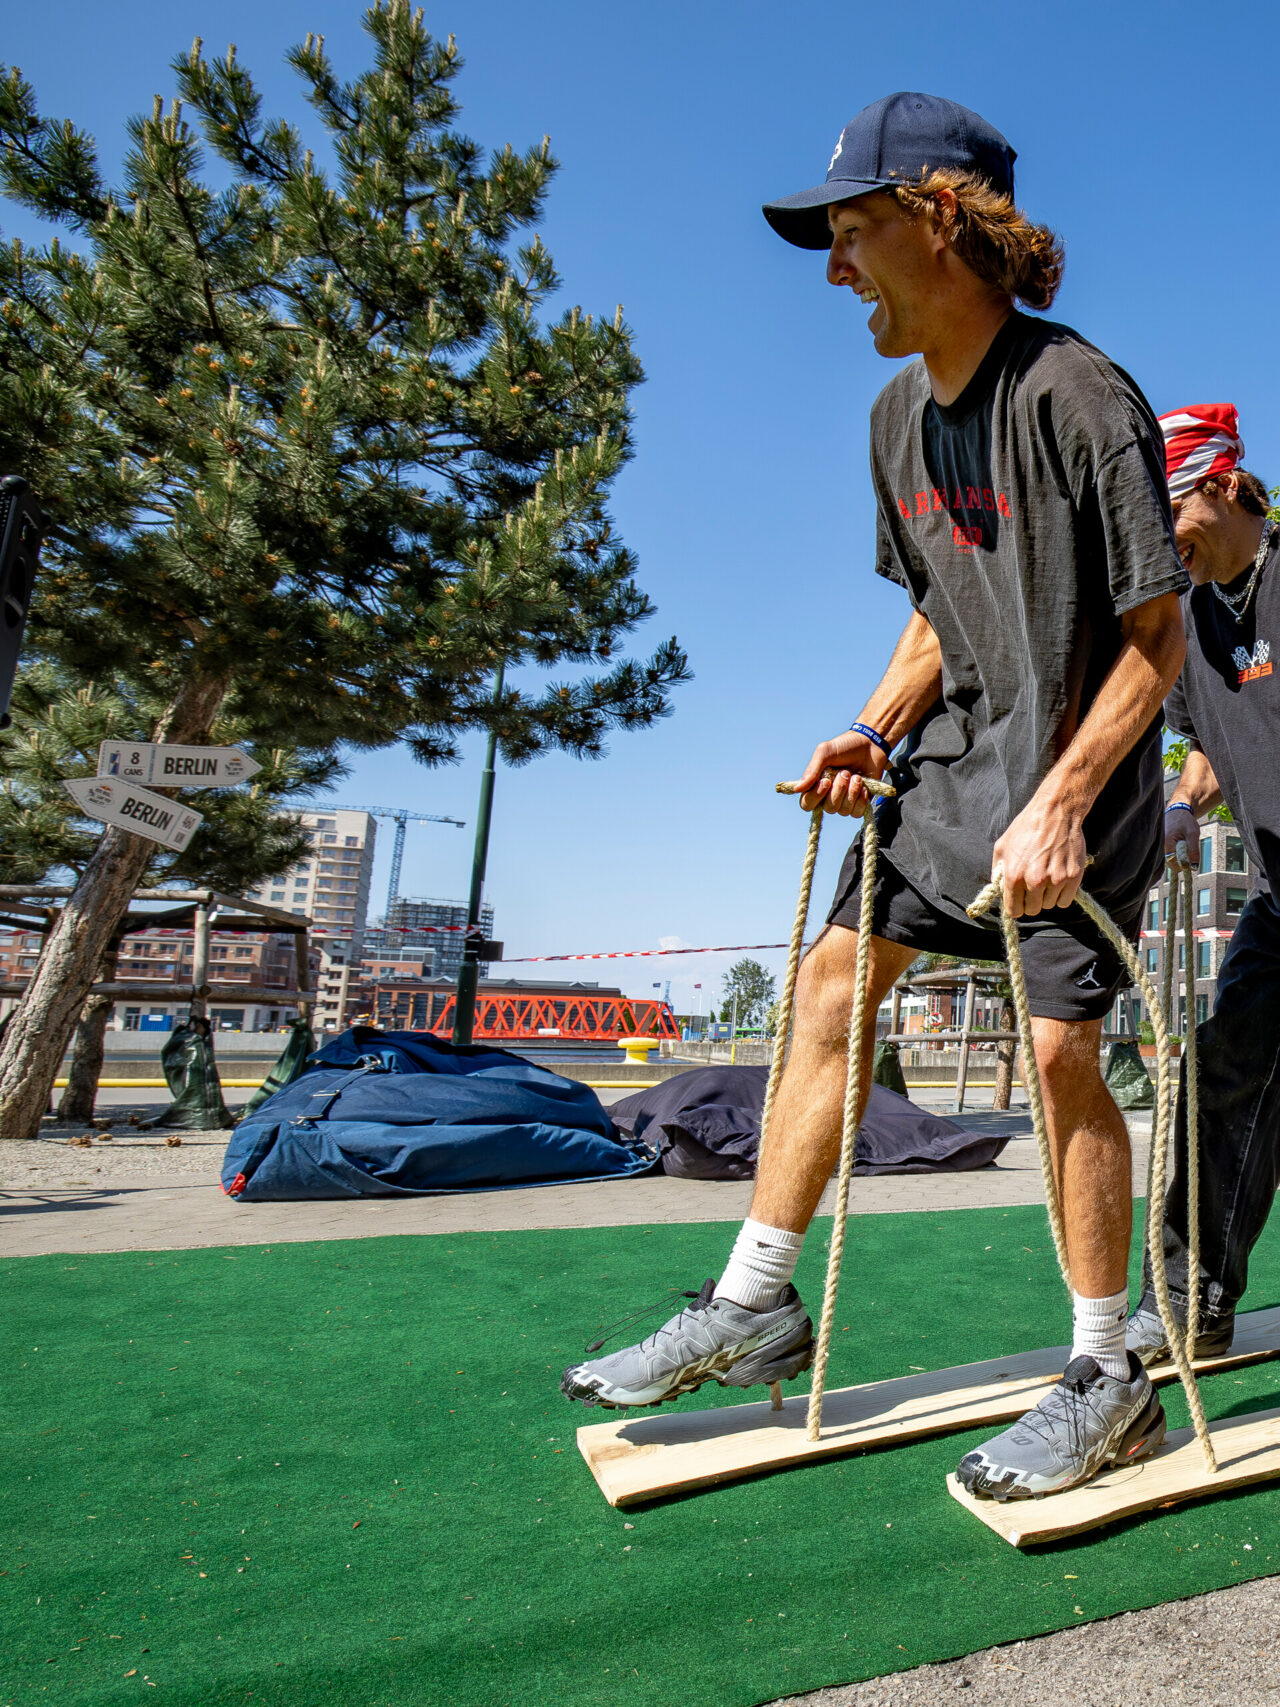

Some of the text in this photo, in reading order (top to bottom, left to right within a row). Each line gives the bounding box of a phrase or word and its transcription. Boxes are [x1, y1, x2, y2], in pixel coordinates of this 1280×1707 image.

[130, 752, 141, 765] 8
[163, 757, 218, 776] BERLIN
[123, 768, 144, 777] CANS
[119, 797, 174, 831] BERLIN
[757, 1322, 787, 1342] SPEED
